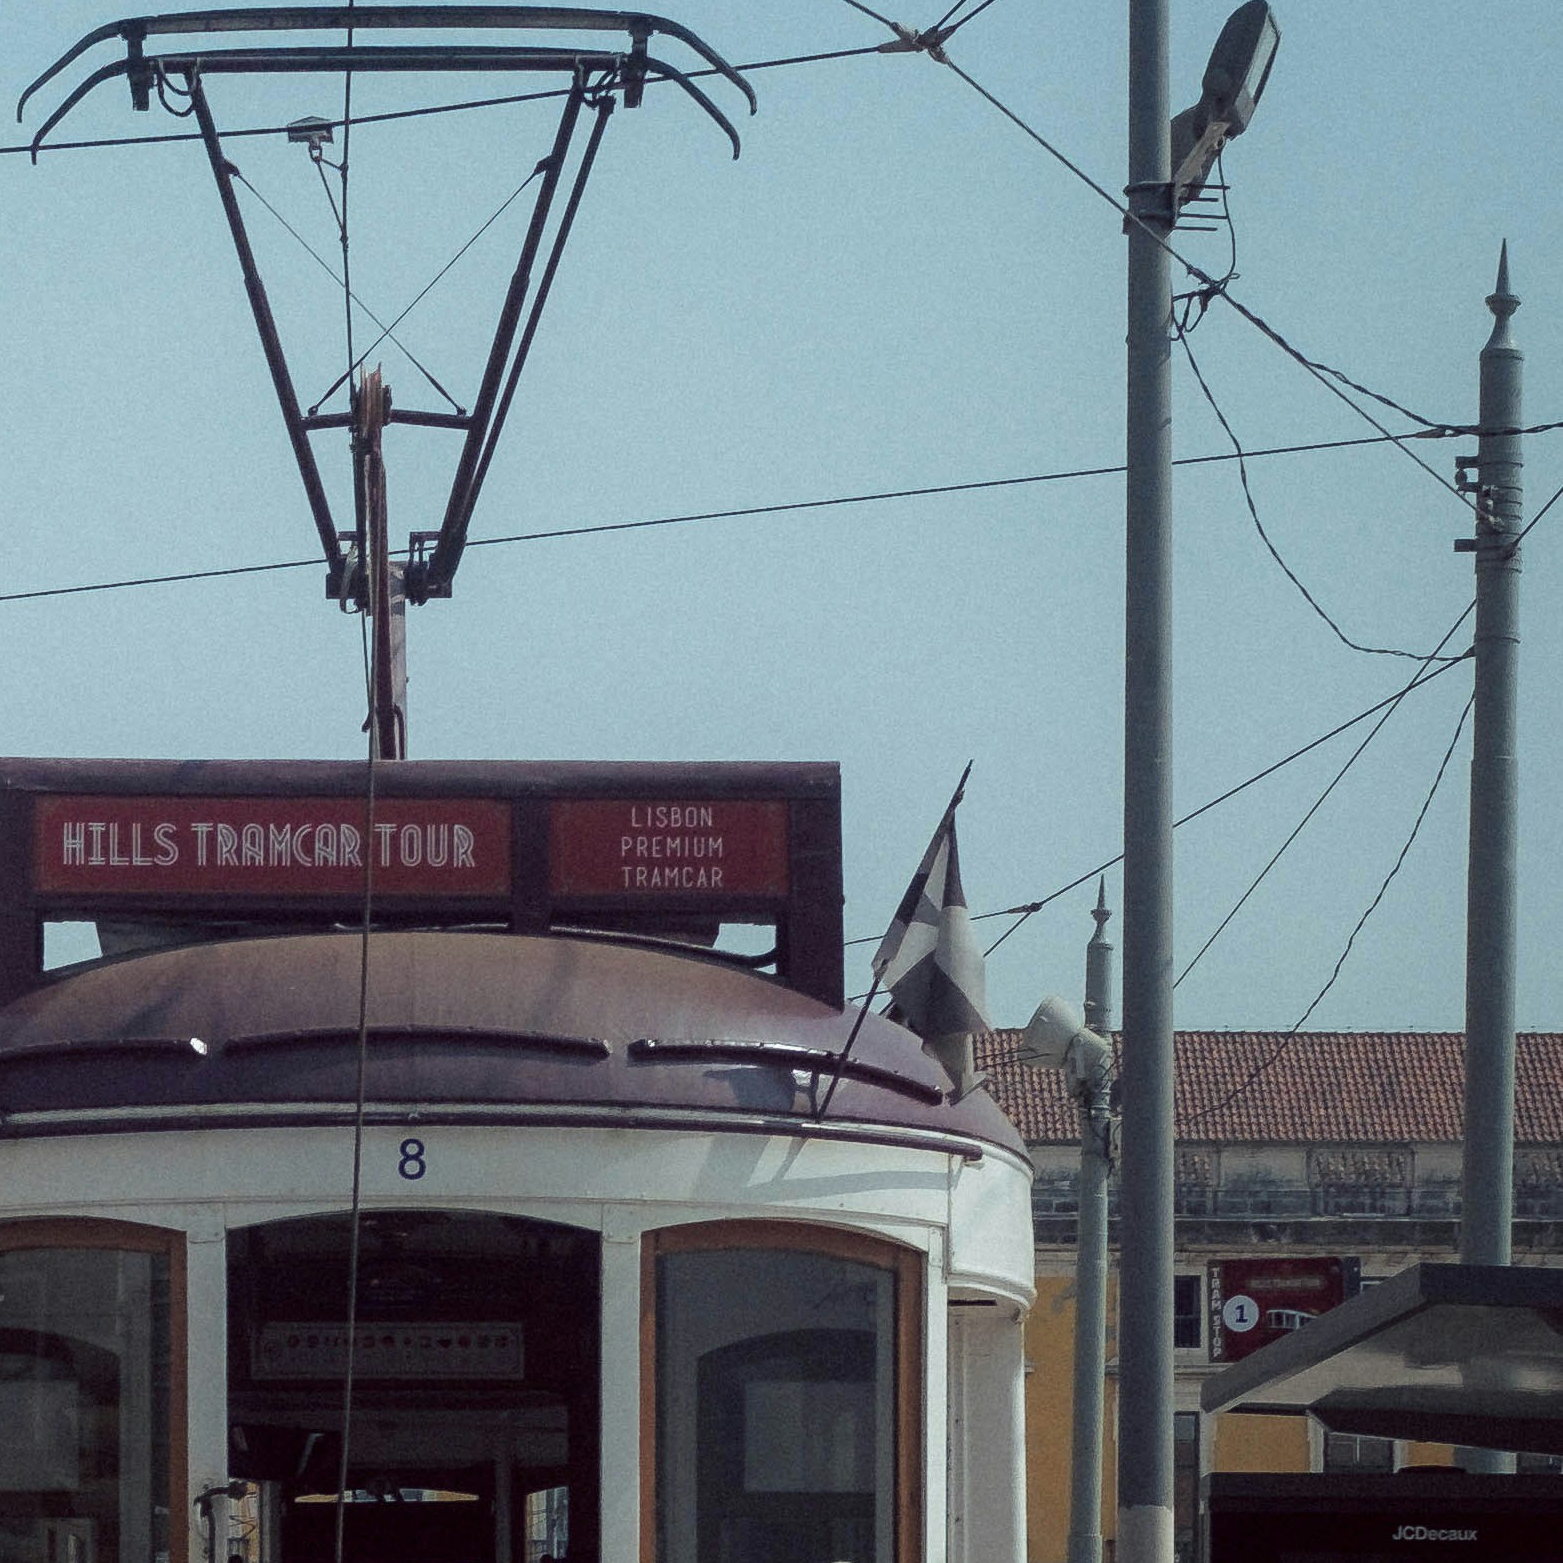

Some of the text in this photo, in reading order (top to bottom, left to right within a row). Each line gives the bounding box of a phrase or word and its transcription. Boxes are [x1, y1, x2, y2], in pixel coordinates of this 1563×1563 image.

[631, 806, 713, 828] LISBON
[63, 822, 476, 867] HILLS TRAMCAR TOUR
[621, 836, 723, 858] PREMIUM
[621, 866, 723, 888] TRAMCAR
[398, 1138, 427, 1181] 8
[1211, 1268, 1222, 1357] TRAM STOP
[1235, 1305, 1248, 1323] 1
[1391, 1524, 1478, 1541] JCDecaux
